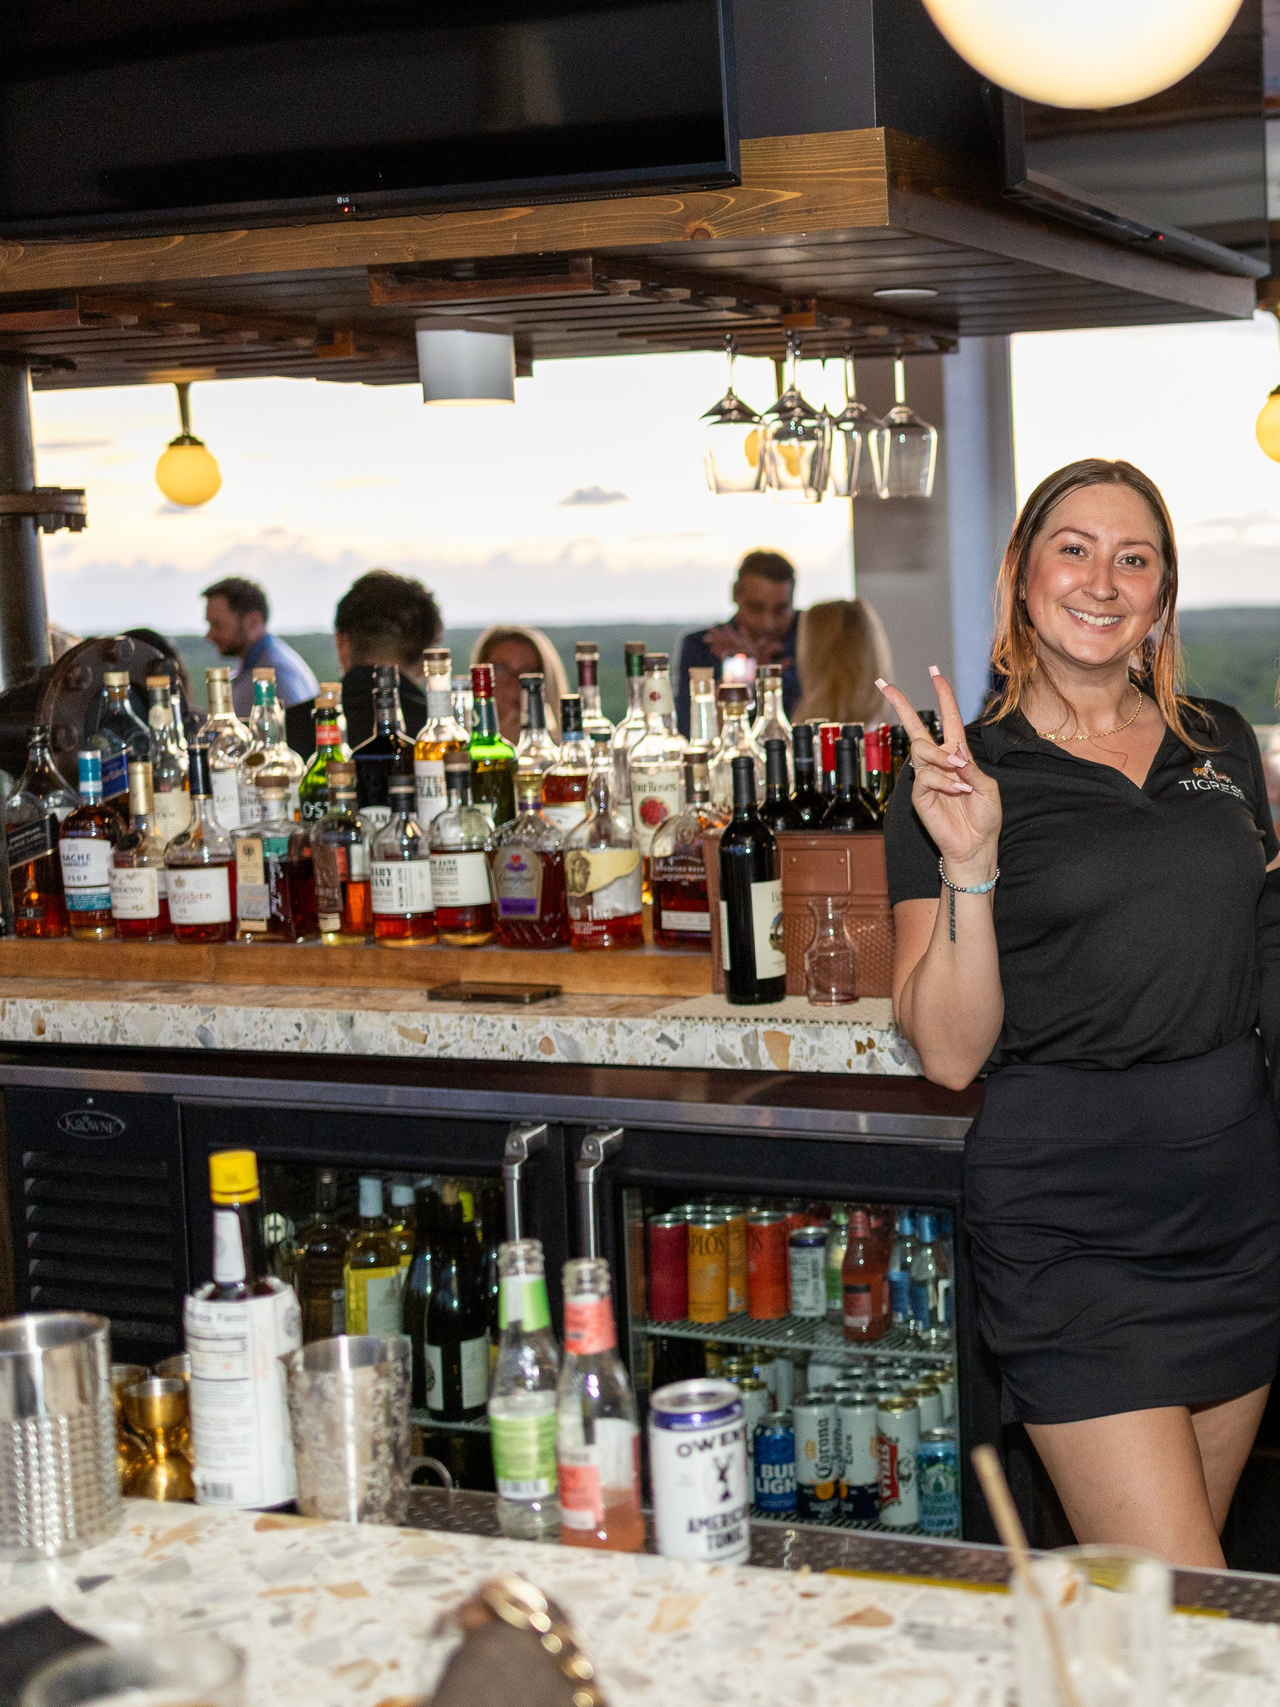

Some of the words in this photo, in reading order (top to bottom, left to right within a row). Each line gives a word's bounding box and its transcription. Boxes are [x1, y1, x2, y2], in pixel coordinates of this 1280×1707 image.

[649, 781, 677, 793] Roses
[1178, 779, 1246, 801] TIGRESS
[815, 1417, 833, 1479] Corona
[756, 1477, 796, 1495] LIGH
